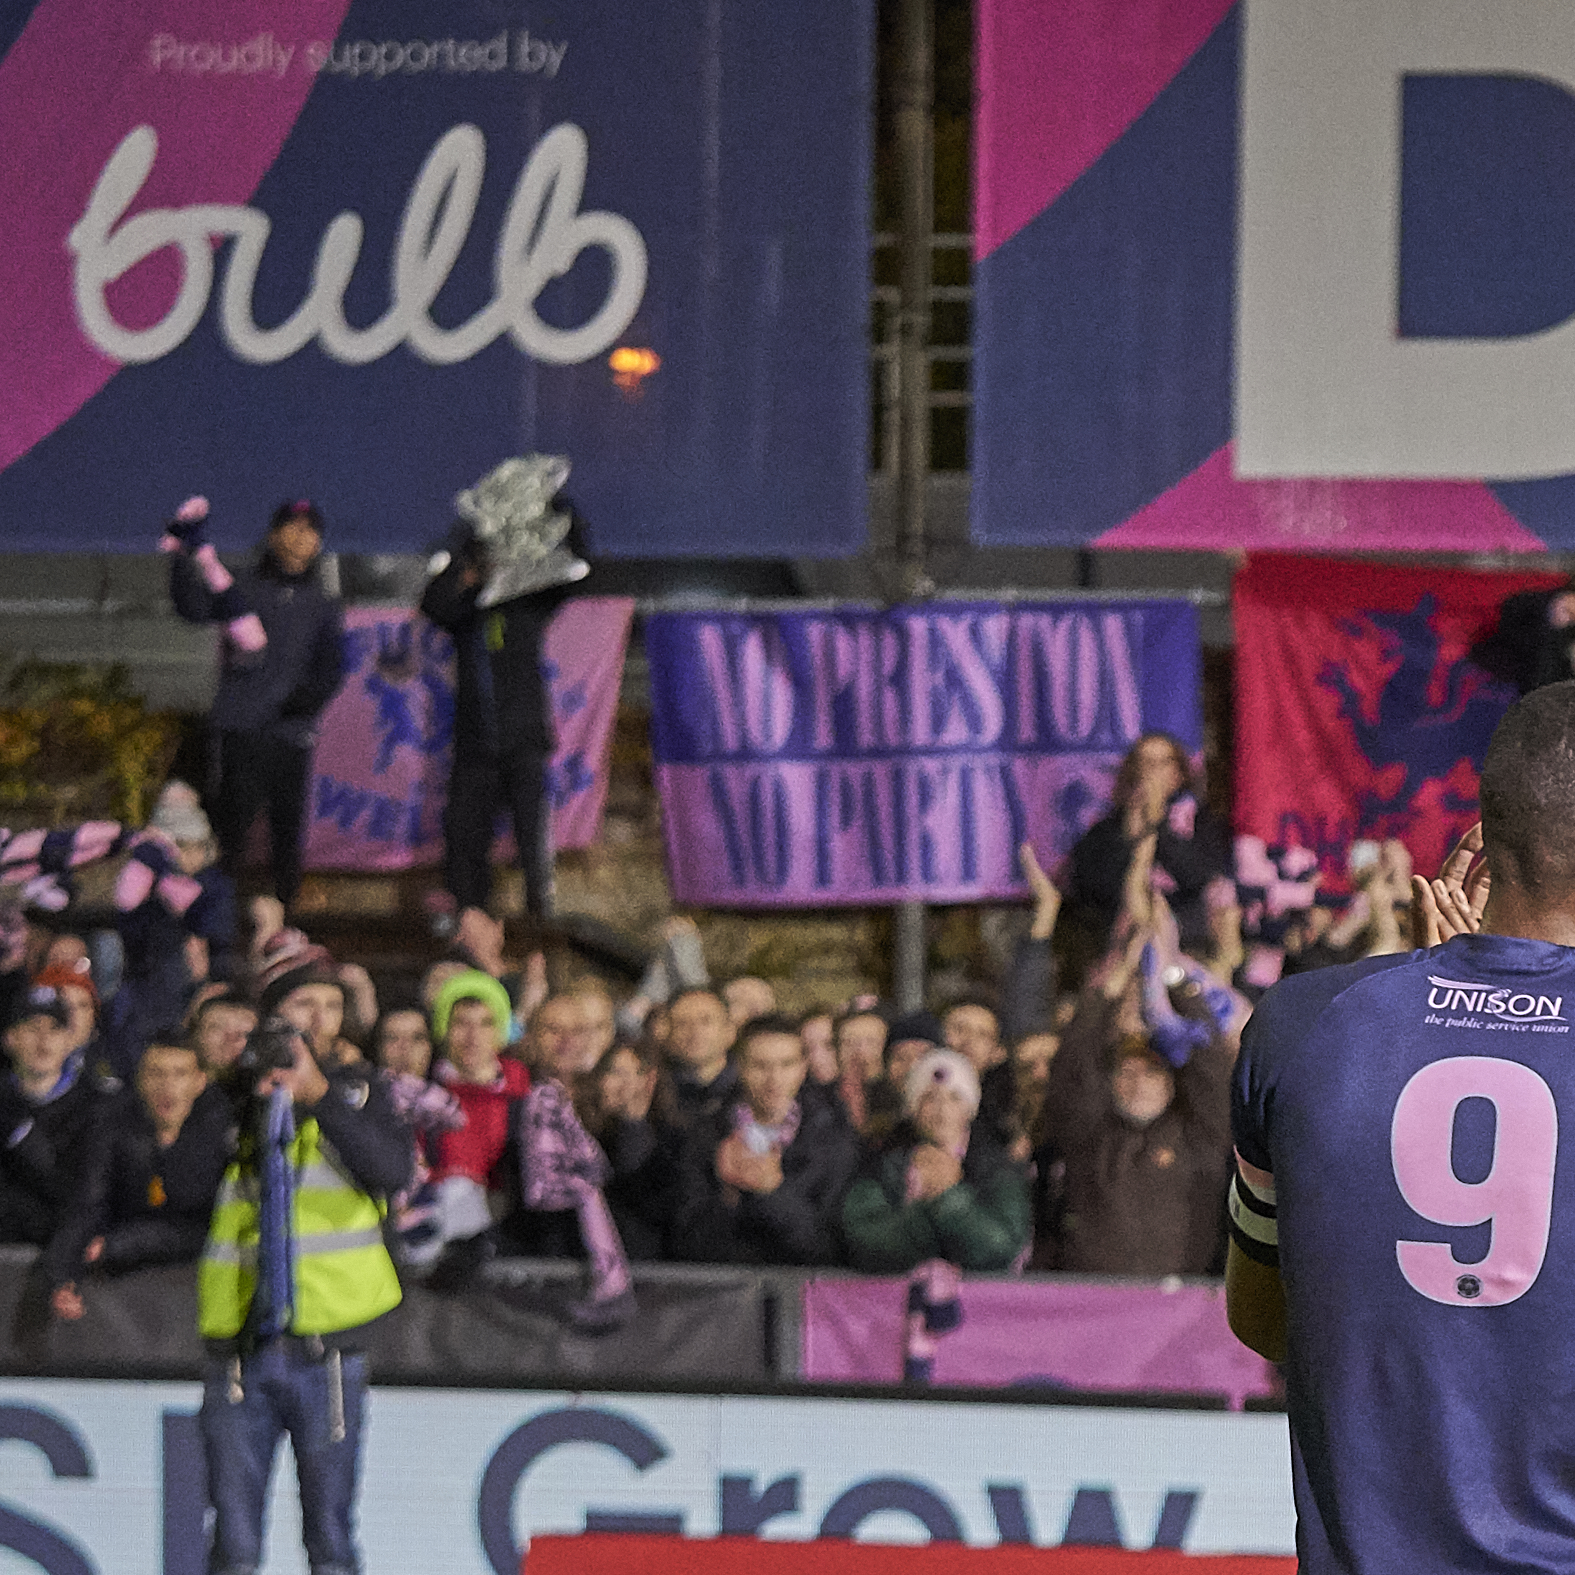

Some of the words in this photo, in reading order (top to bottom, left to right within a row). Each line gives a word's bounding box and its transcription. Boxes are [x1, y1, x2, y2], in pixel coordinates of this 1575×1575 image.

[150, 31, 295, 80] Proudly
[308, 31, 508, 79] supported
[517, 31, 569, 80] by
[68, 123, 648, 365] bulb
[698, 619, 796, 753] NO
[807, 611, 1145, 753] PRESTON
[1424, 1013, 1442, 1026] the
[1444, 1017, 1483, 1030] public
[1486, 1021, 1530, 1033] service
[1532, 1023, 1570, 1034] union
[1427, 986, 1563, 1018] UNISON
[1390, 1056, 1559, 1307] 9
